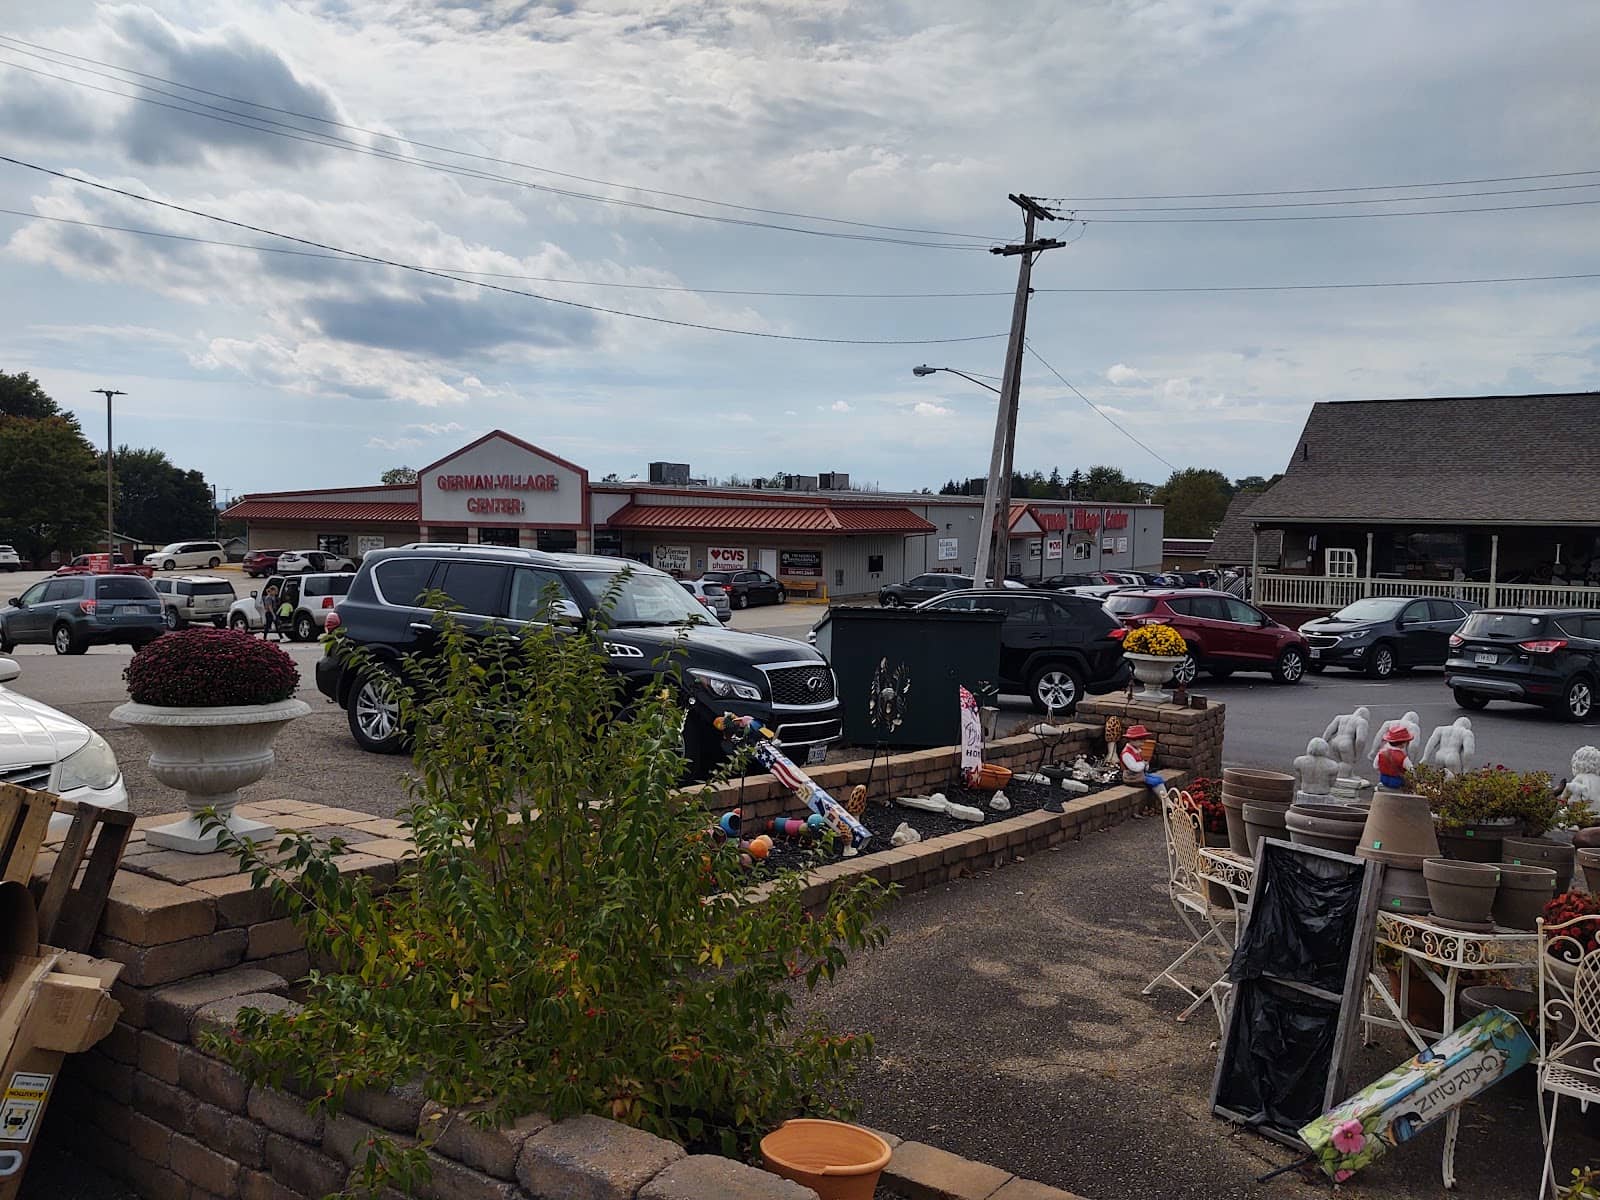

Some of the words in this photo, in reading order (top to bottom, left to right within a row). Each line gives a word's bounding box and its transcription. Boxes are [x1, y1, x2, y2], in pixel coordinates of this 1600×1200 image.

[437, 475, 495, 491] GERMAN
[498, 475, 557, 491] VILLAGE
[467, 497, 523, 513] CENTER
[722, 550, 745, 561] CVS
[657, 560, 686, 569] Market
[712, 562, 744, 570] pharmacy
[1414, 1055, 1498, 1114] GARDEN
